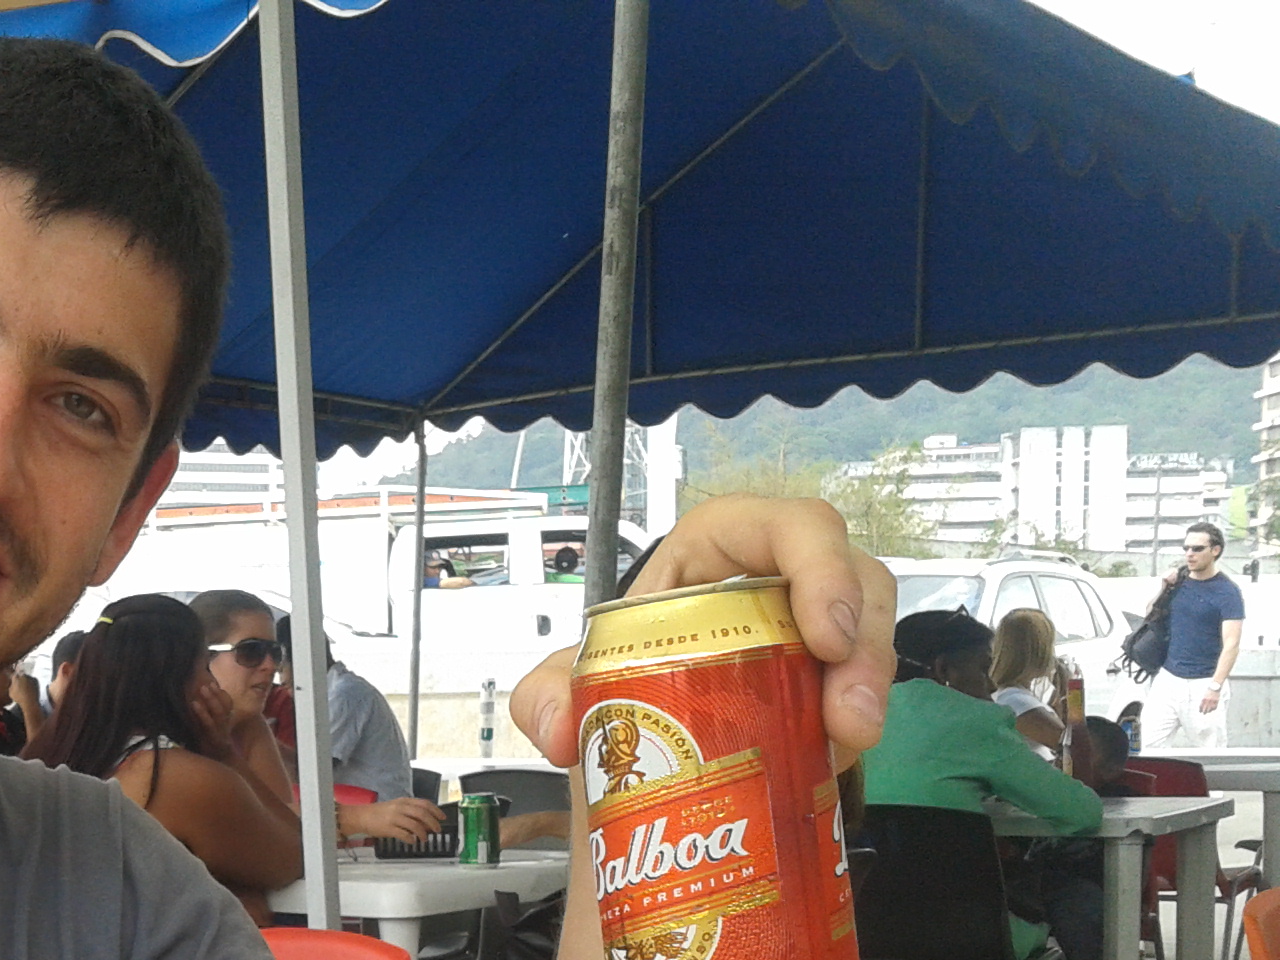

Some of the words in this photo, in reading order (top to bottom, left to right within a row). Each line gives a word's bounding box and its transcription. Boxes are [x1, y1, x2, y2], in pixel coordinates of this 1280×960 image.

[643, 633, 700, 650] DESDE
[604, 708, 636, 719] CON
[589, 815, 751, 901] Balboa
[643, 865, 755, 907] PREMIUM
